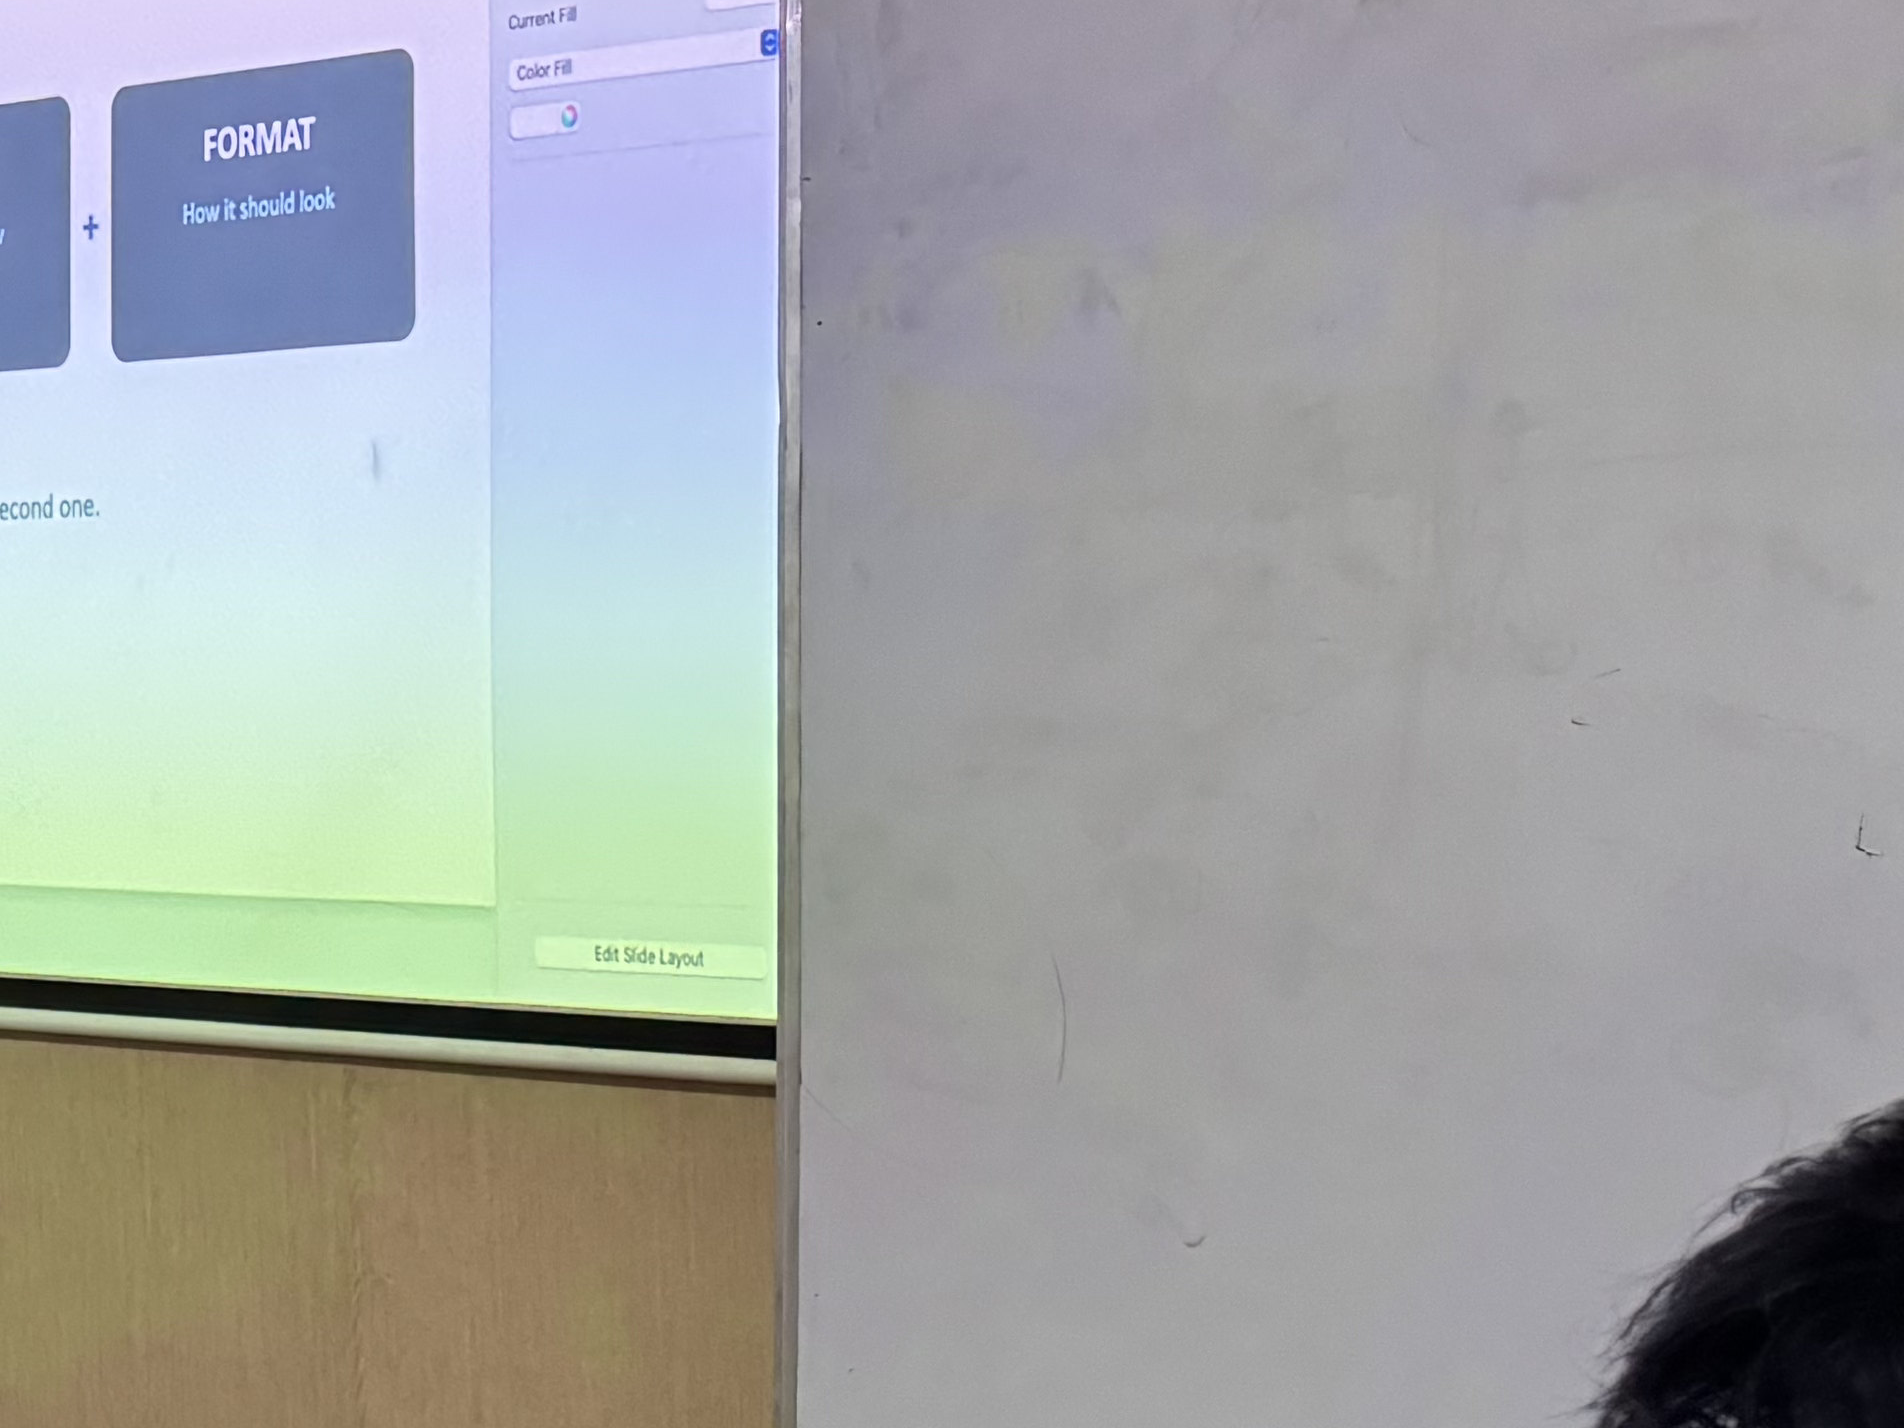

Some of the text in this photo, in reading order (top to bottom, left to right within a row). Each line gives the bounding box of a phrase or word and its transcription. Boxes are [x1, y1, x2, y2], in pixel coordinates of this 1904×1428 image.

[508, 5, 578, 31] Current Fill
[516, 58, 573, 82] Color Fill
[203, 116, 316, 162] FORMAT
[182, 185, 336, 226] How it should look
[59, 497, 101, 519] one.
[594, 945, 705, 969] Edit Slide Layout
